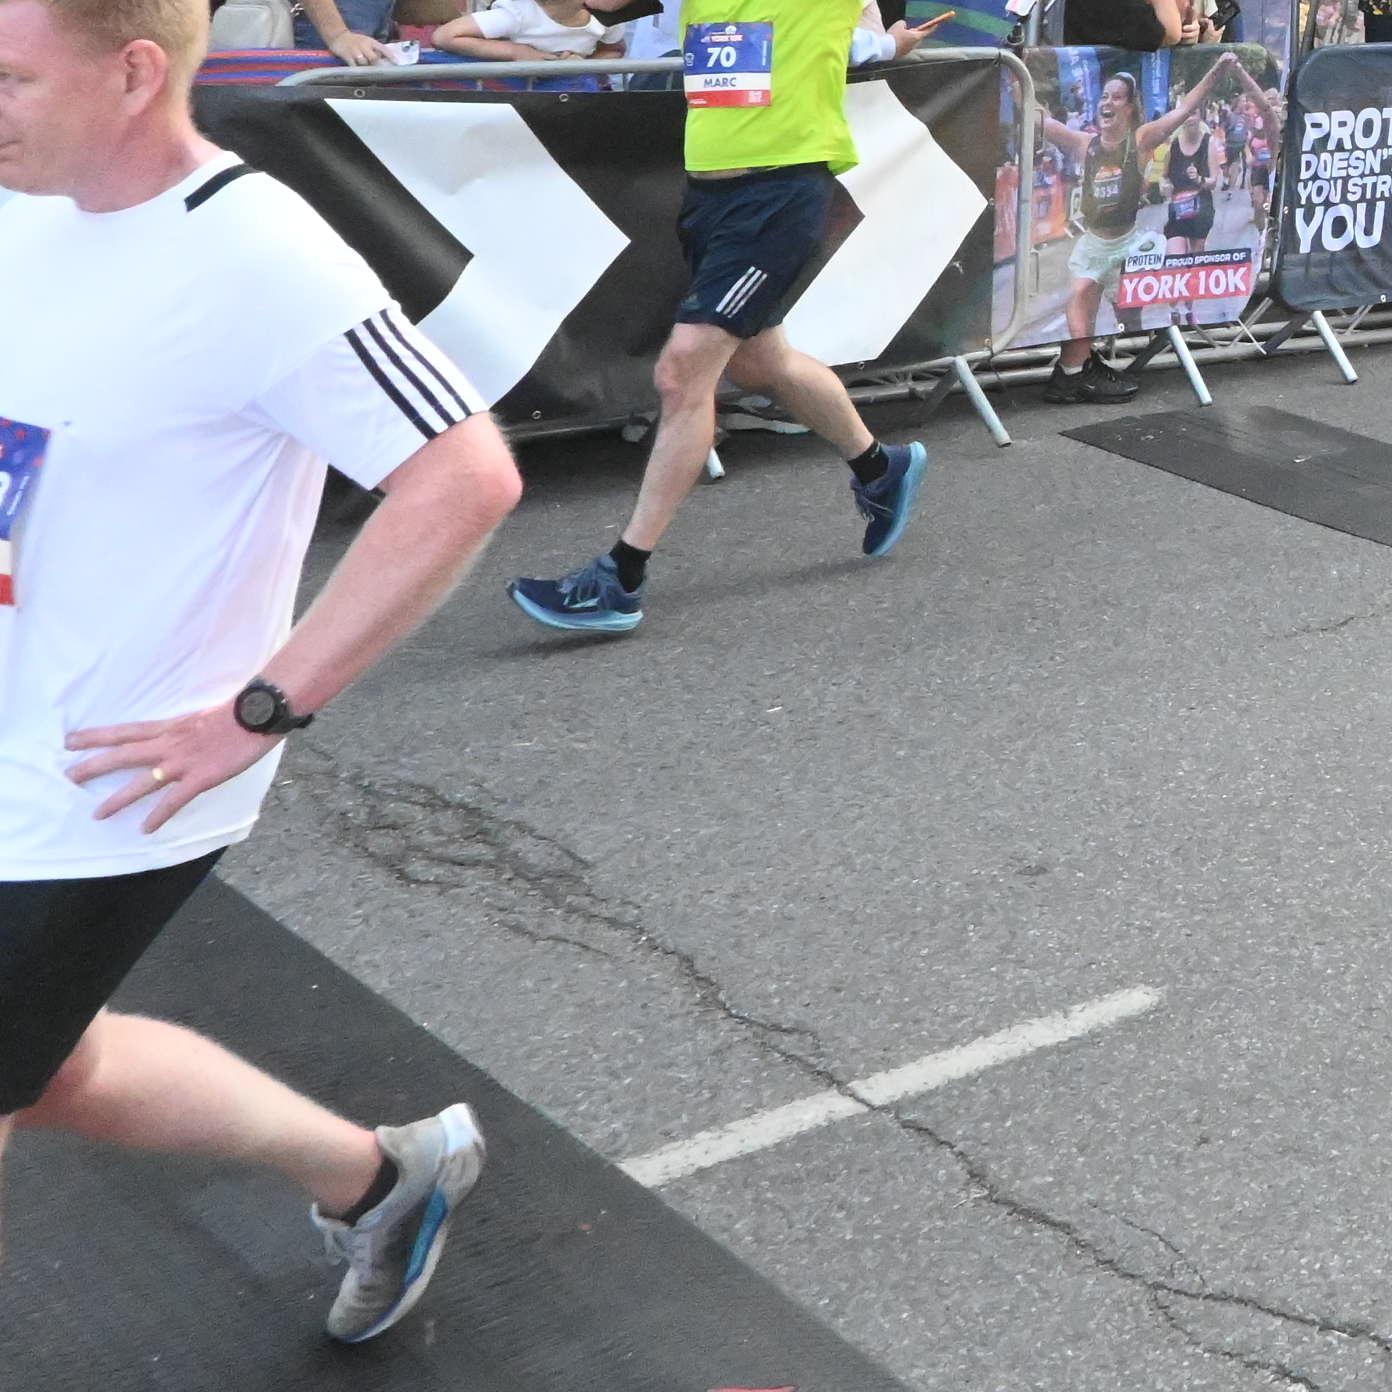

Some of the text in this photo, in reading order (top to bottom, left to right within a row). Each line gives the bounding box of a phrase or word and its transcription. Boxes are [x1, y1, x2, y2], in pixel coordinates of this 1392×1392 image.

[706, 45, 737, 68] 70
[703, 77, 737, 88] MARC
[1297, 179, 1342, 205] YOU
[1295, 201, 1385, 254] YOU
[1127, 253, 1162, 266] PROTEIN
[1232, 252, 1247, 261] OF
[1123, 266, 1248, 303] YORK 10K
